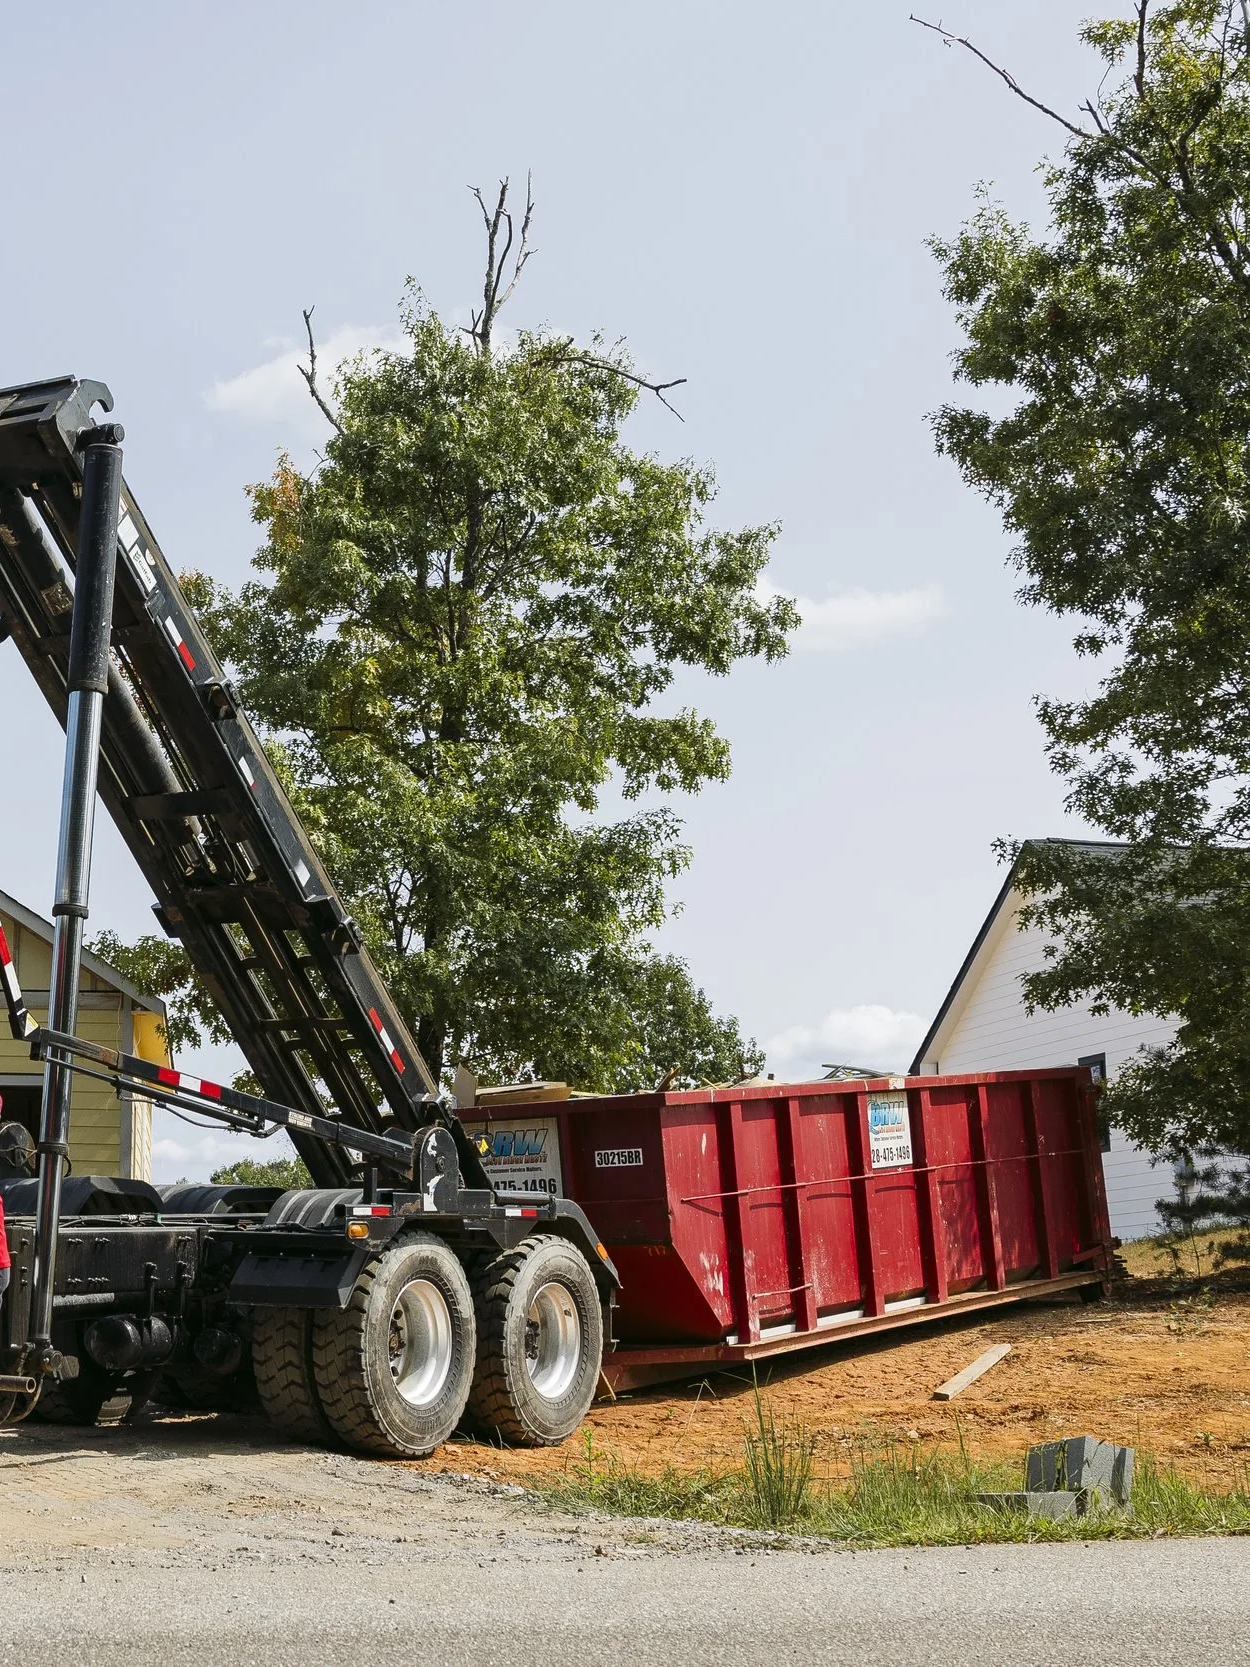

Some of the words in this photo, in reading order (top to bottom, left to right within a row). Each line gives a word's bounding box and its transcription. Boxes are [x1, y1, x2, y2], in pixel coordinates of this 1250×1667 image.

[871, 1101, 905, 1126] BRW
[596, 1150, 642, 1166] 30215BR
[872, 1145, 911, 1163] 28-475-1496
[493, 1178, 557, 1194] 475-1496
